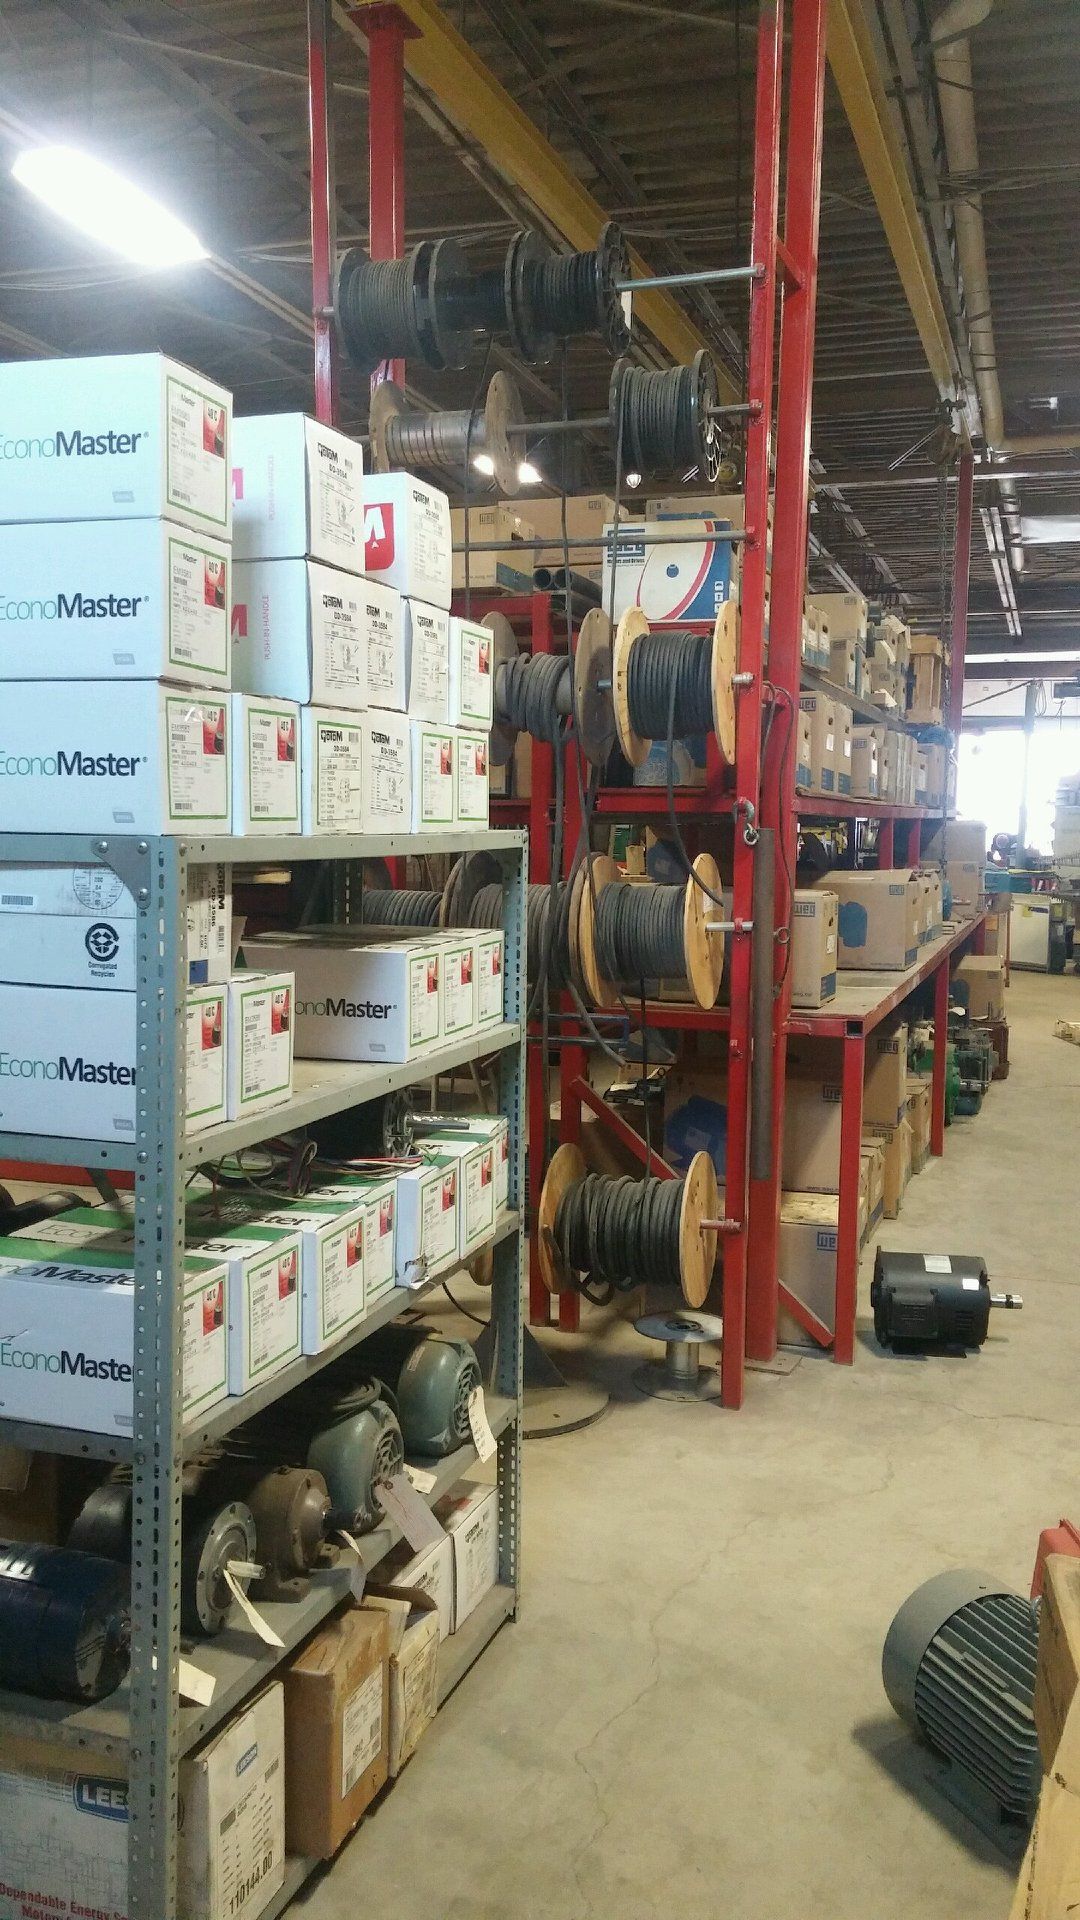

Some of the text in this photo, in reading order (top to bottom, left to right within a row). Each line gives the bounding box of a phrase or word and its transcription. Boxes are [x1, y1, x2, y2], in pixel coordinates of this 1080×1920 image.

[295, 998, 391, 1019] onoMaster
[1, 1342, 134, 1383] EconoMaste
[82, 1784, 128, 1811] LEE
